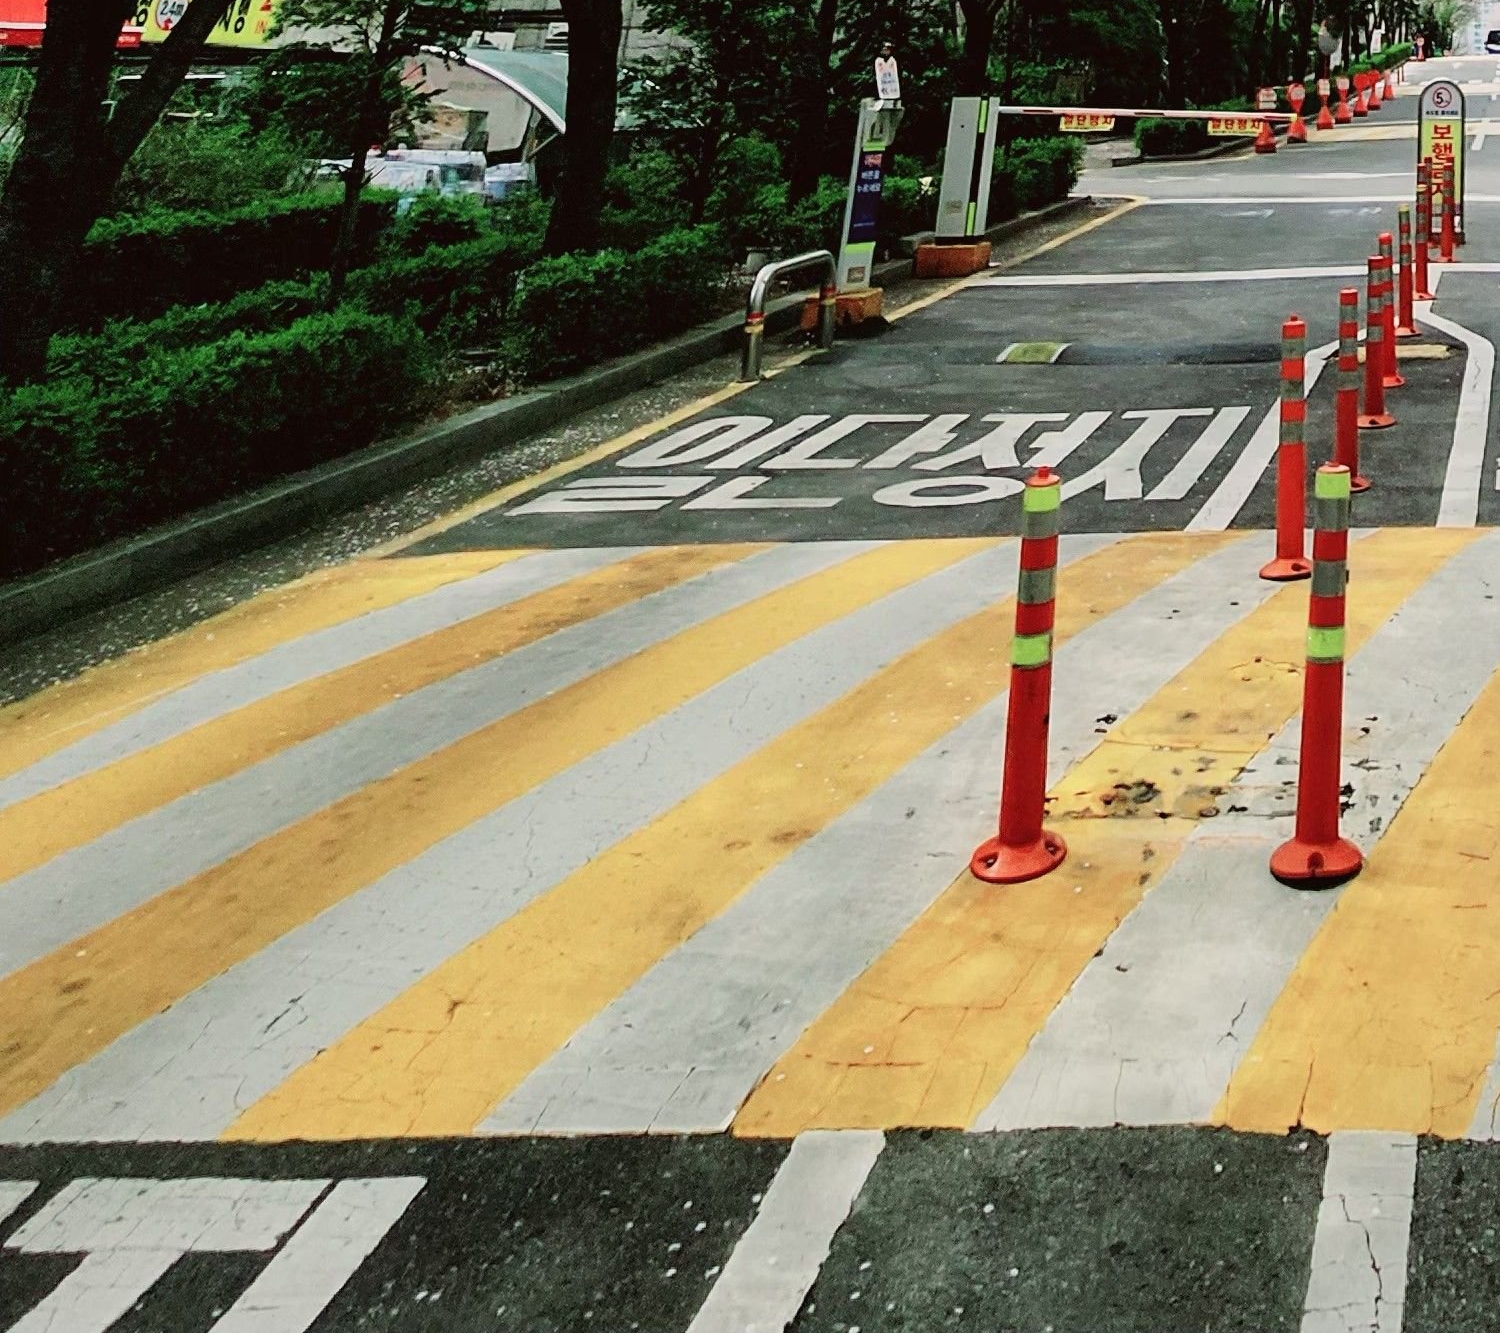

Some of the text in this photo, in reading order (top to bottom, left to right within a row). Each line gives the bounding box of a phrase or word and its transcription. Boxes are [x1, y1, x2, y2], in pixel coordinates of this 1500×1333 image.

[1063, 114, 1113, 126] 일단정지
[1211, 117, 1262, 130] 일단정지
[503, 406, 1252, 517] 일단정지
